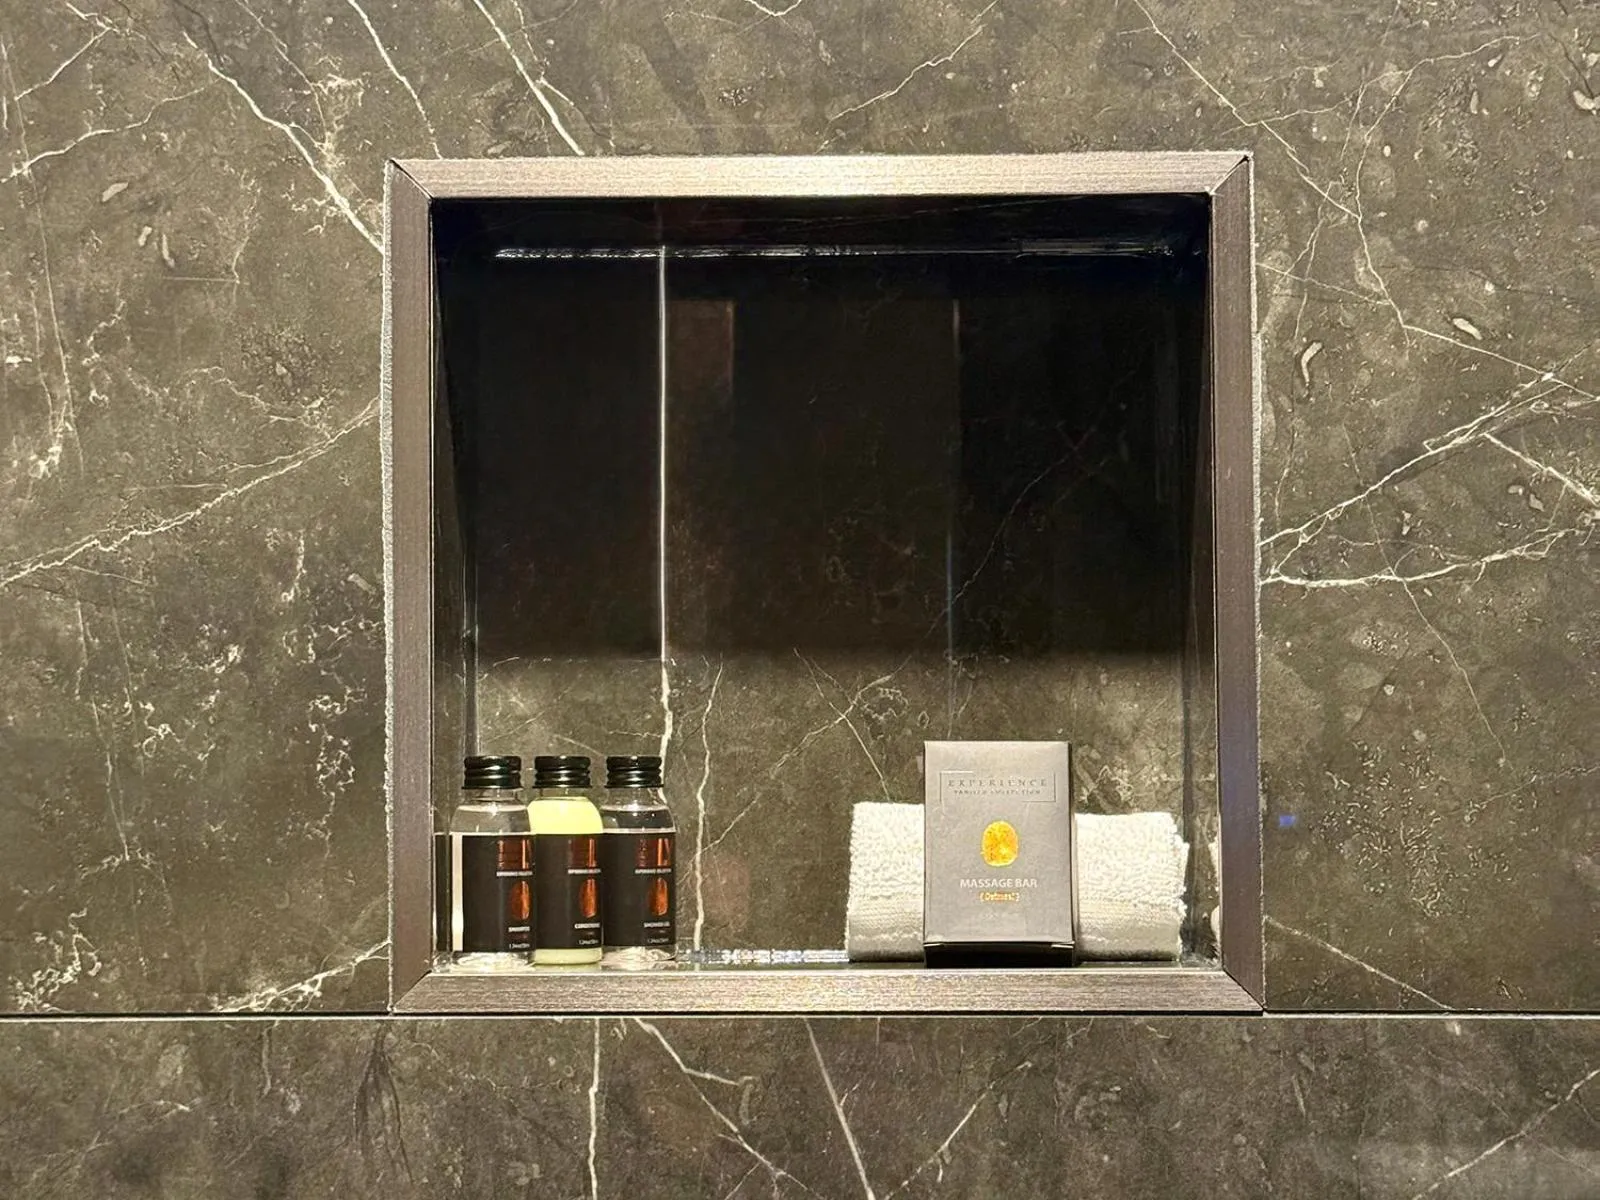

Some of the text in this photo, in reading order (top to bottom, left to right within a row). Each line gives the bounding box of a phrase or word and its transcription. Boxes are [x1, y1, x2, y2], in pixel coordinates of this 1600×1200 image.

[948, 779, 1047, 787] EXPERIENCE
[960, 878, 1038, 888] MASSAGE BAR
